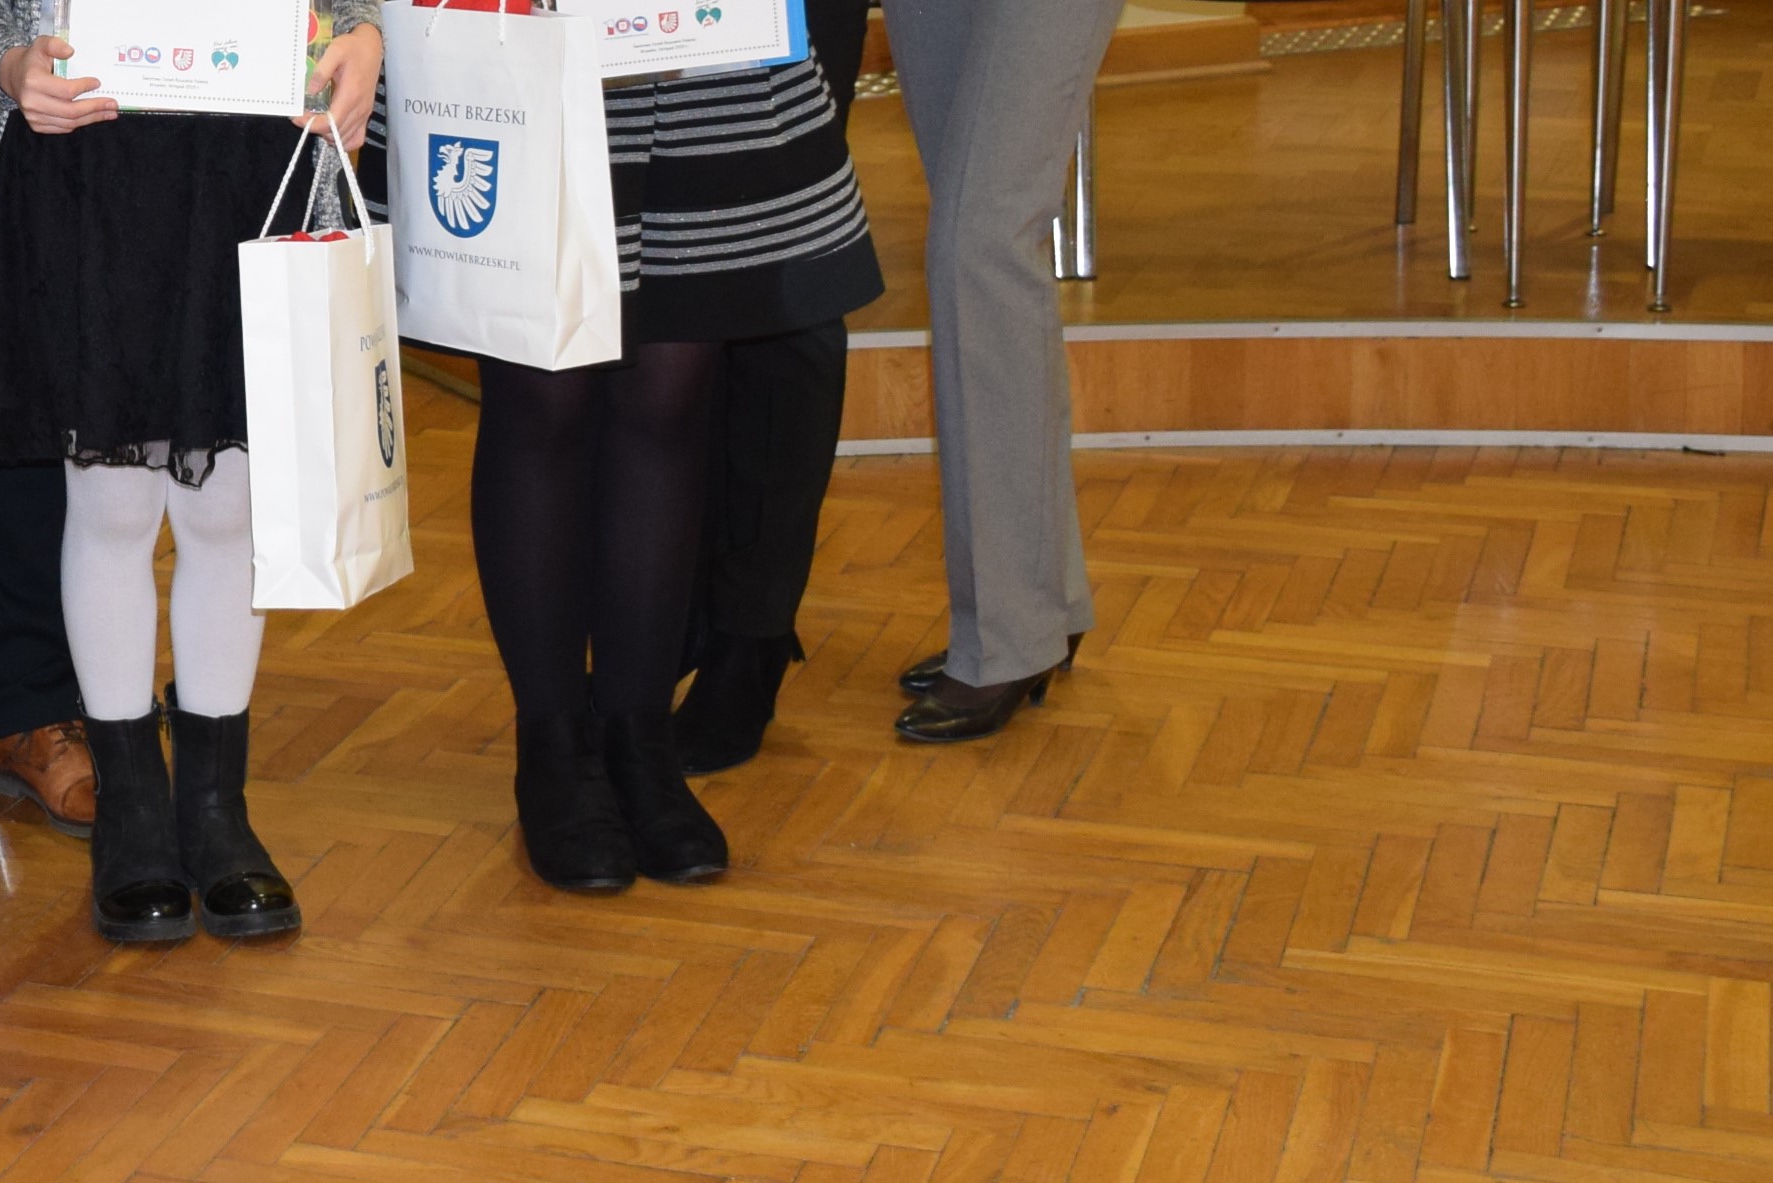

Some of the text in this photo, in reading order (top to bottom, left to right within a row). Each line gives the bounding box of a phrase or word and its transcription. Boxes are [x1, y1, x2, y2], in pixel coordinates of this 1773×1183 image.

[404, 98, 526, 126] POWIAT BRZESKI
[407, 244, 522, 271] WWW.POWIATBRZESKI.PL
